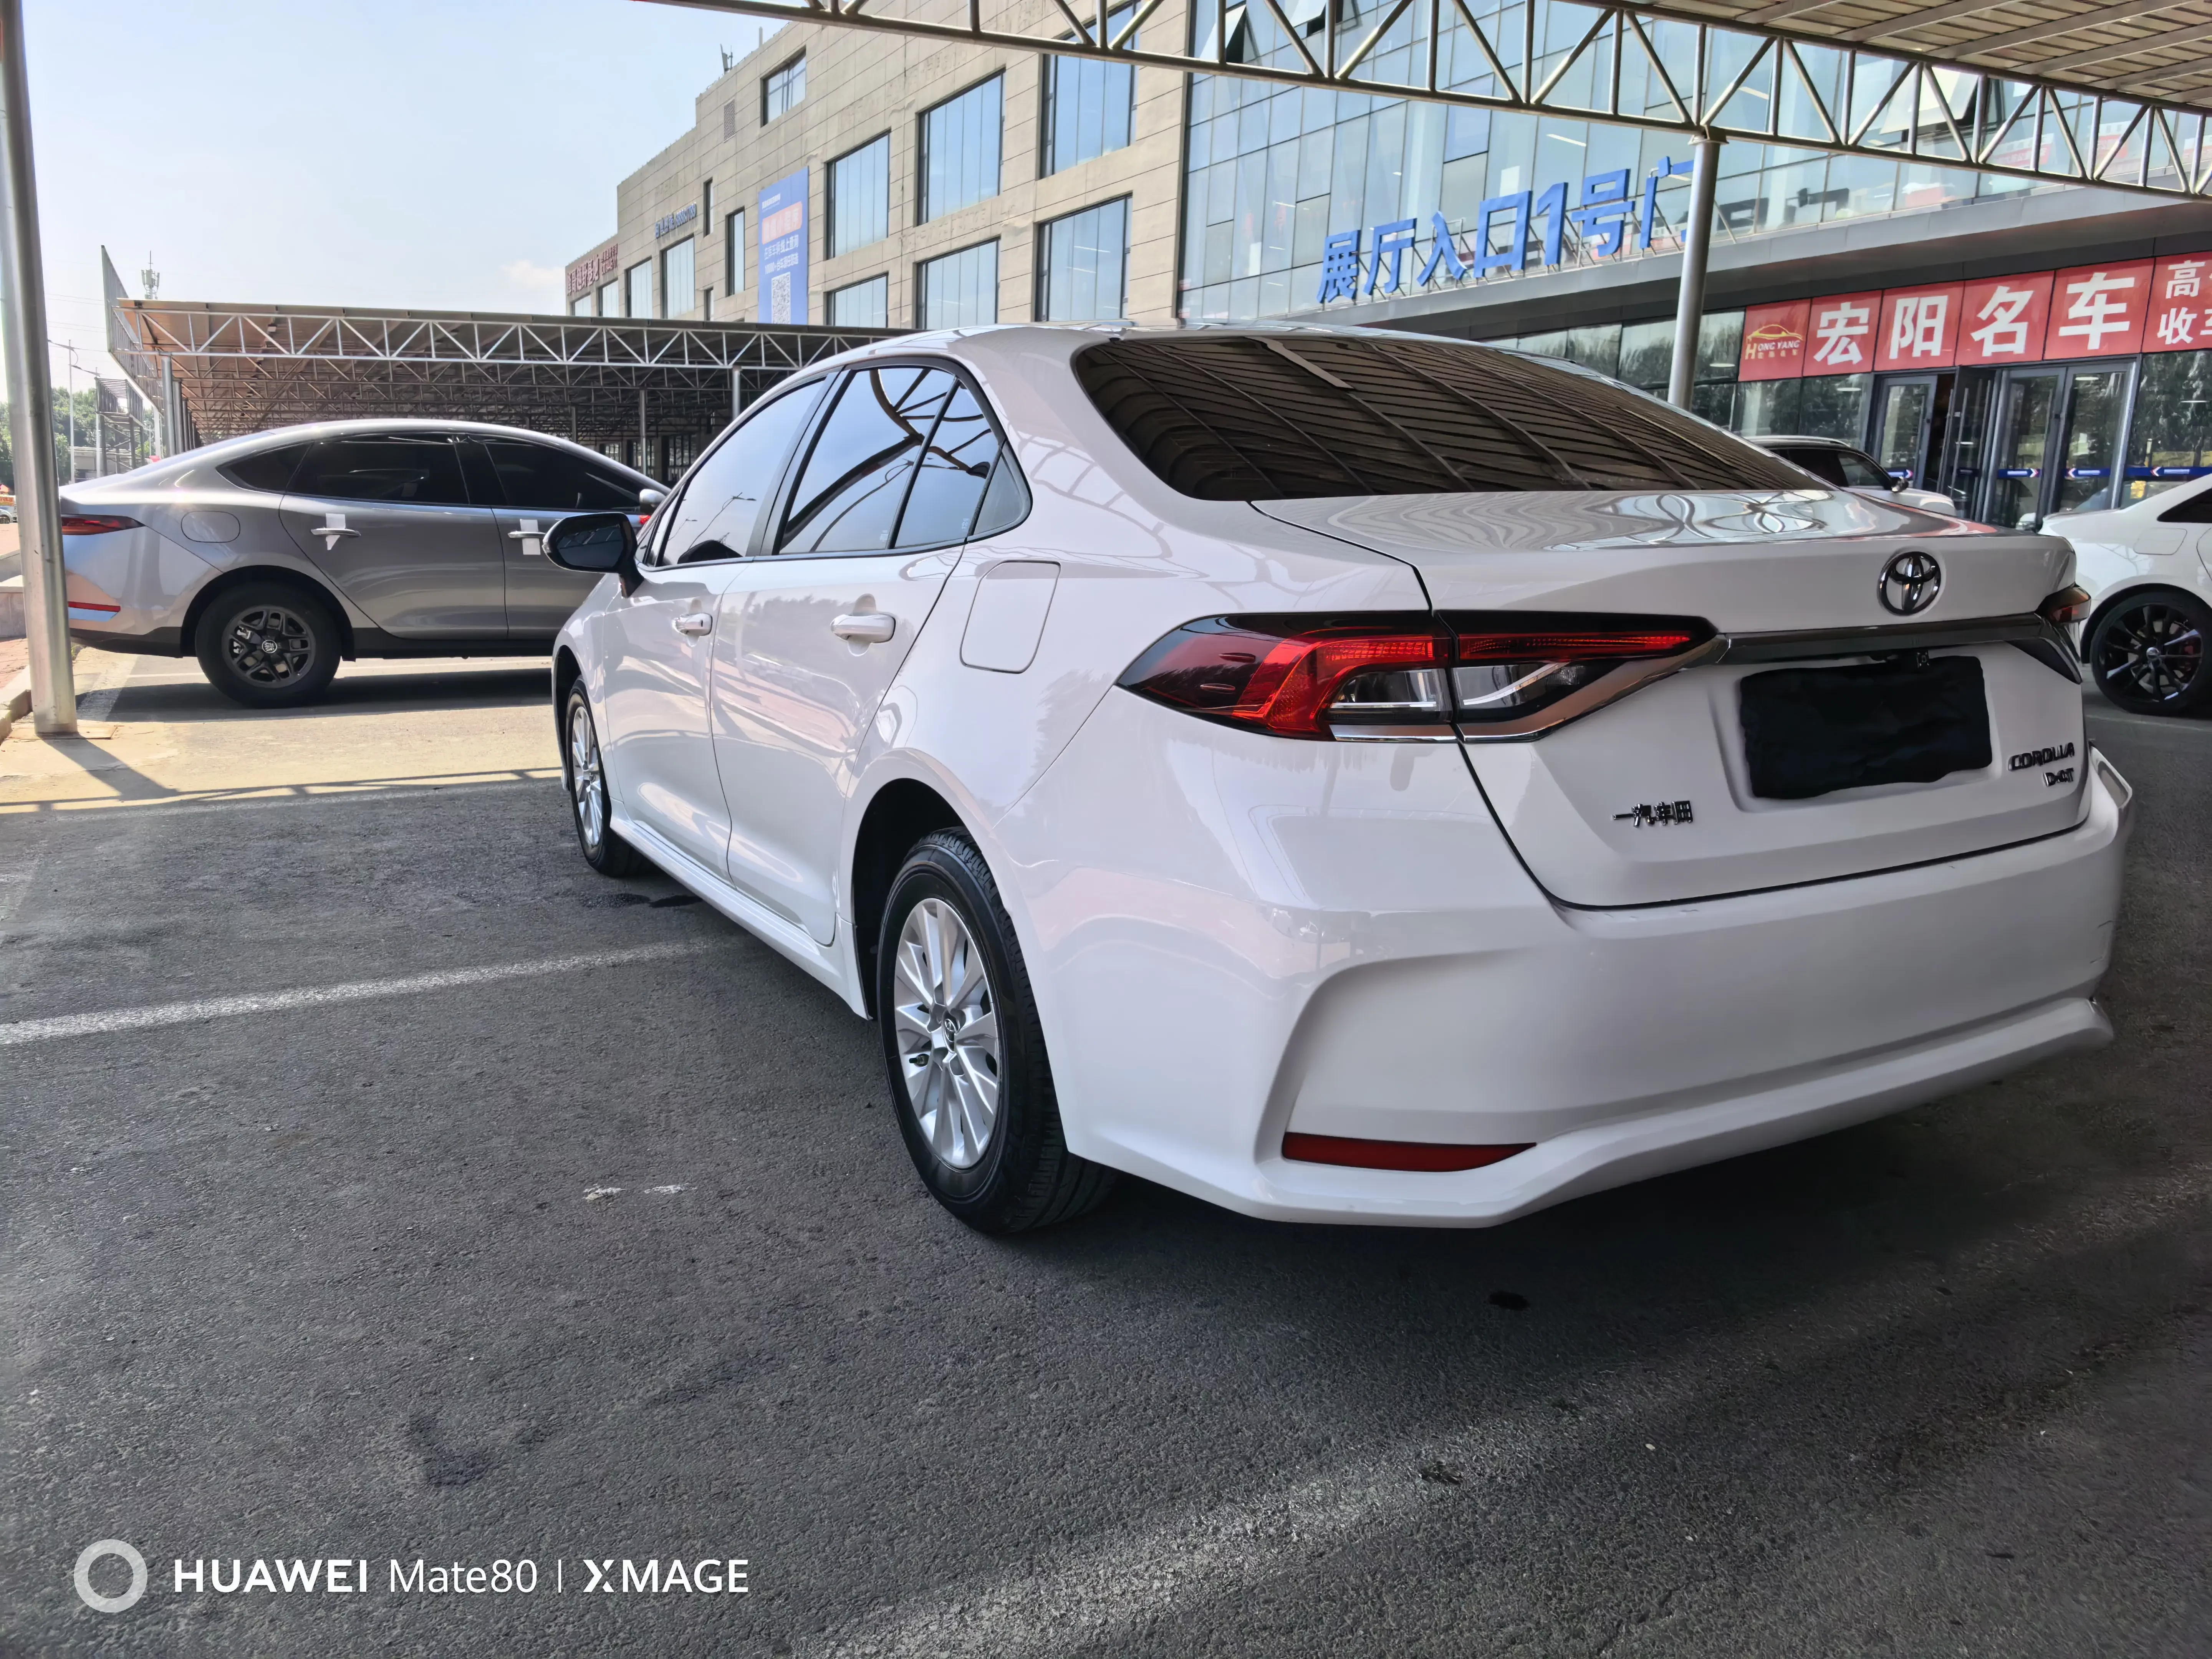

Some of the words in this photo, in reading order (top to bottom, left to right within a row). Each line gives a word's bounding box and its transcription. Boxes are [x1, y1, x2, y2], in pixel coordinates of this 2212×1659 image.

[1812, 272, 2135, 366] 宏阳名车
[1745, 342, 1776, 360] HONG
[1777, 339, 1800, 349] YANG
[2008, 742, 2075, 772] COROLLA
